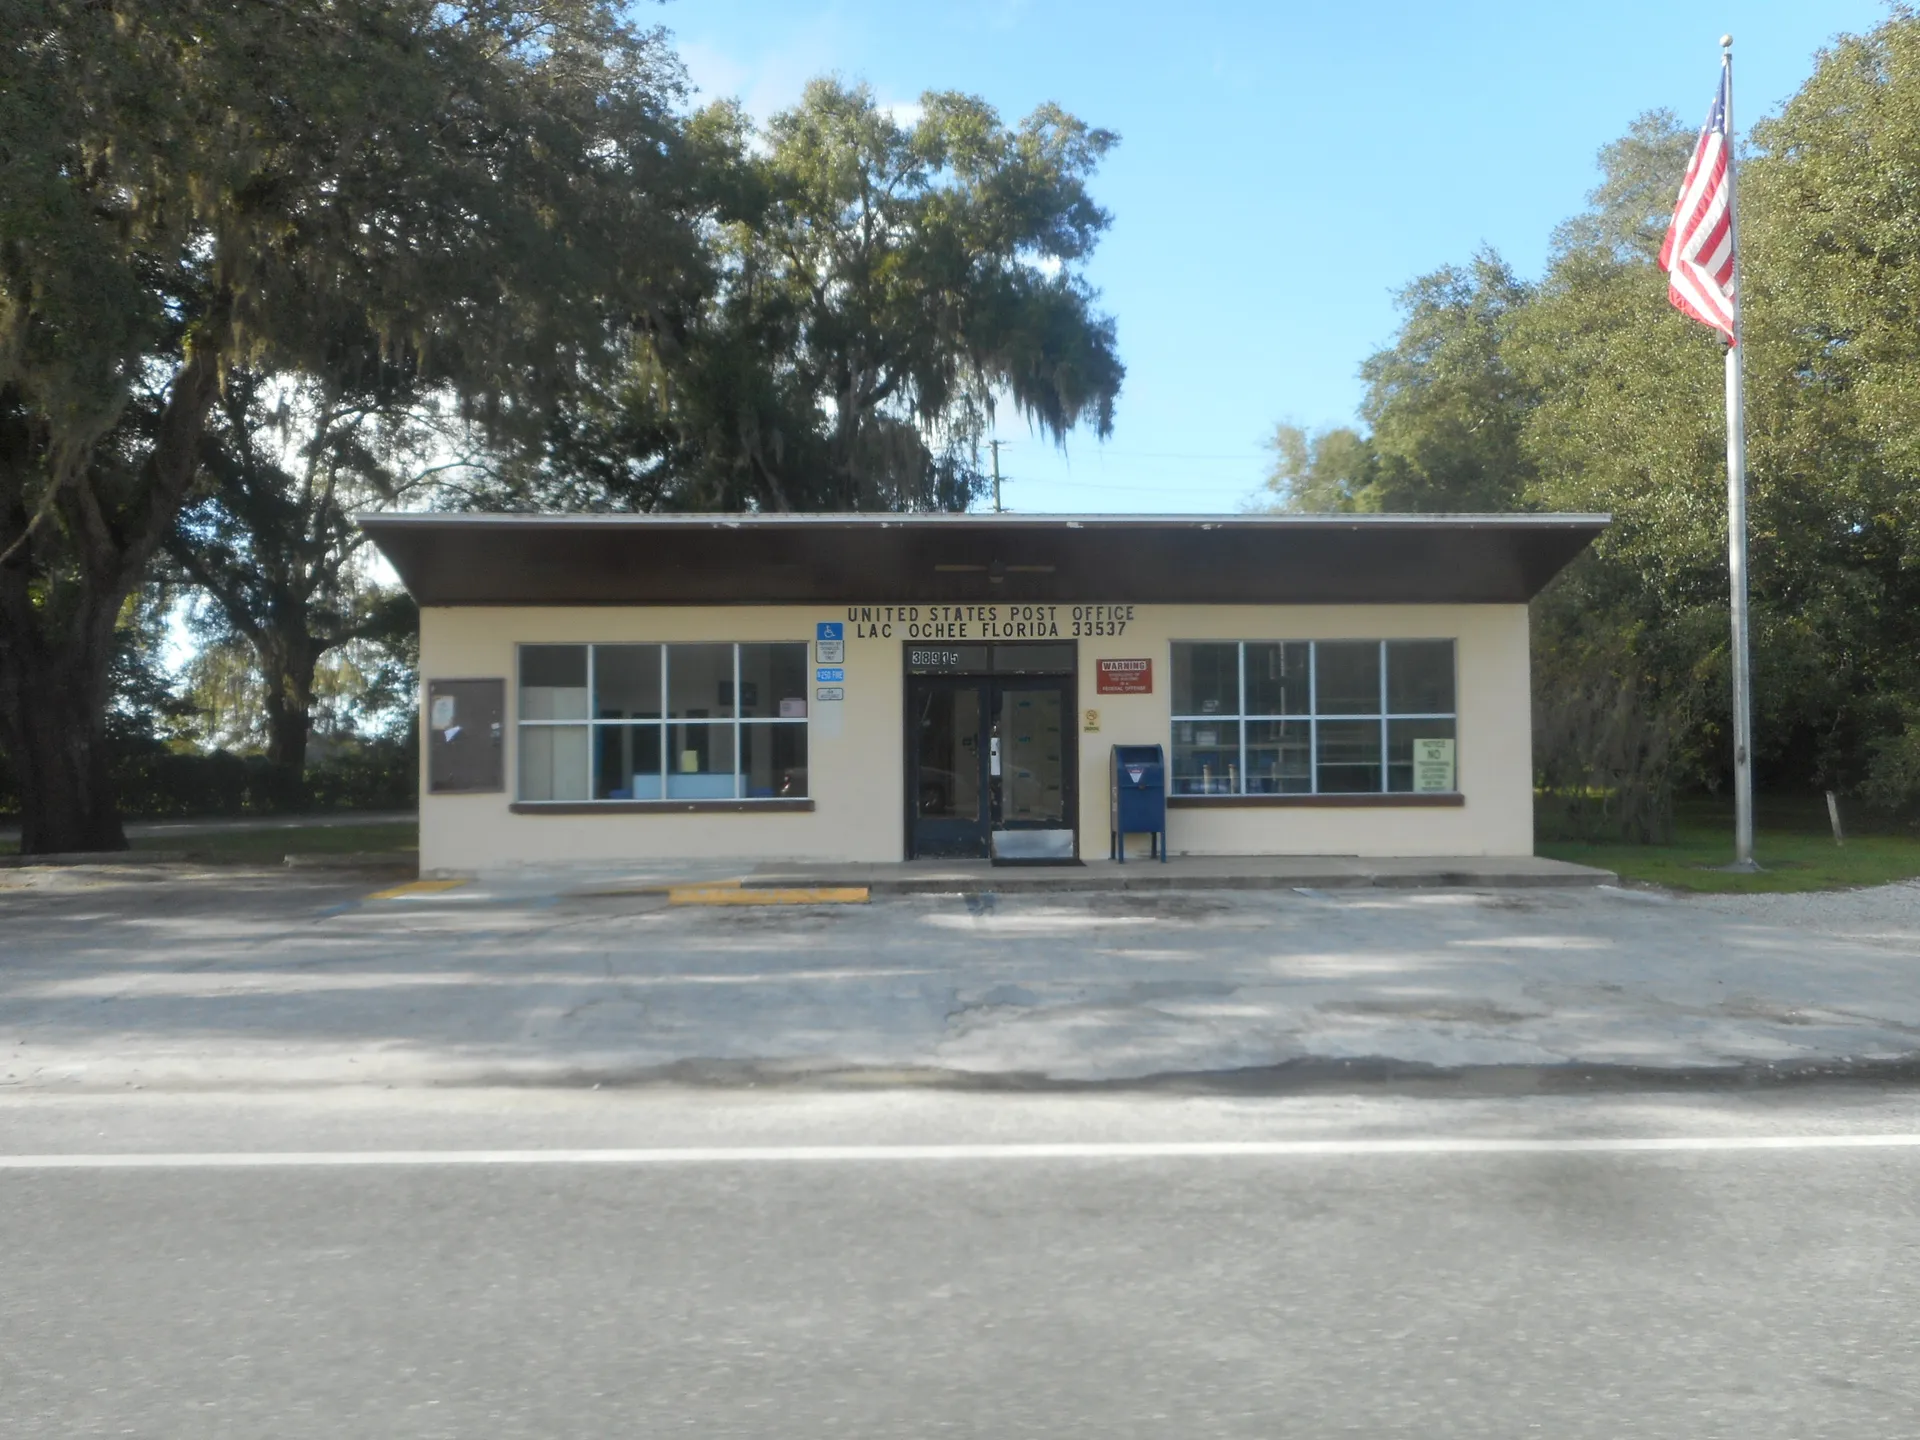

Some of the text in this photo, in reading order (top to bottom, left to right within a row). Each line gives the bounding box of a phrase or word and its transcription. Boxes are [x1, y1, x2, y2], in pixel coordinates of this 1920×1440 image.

[848, 606, 1134, 622] UNITED STATES POST OFFICE
[982, 622, 1059, 637] FLORIDA
[1072, 621, 1126, 637] 33537
[912, 651, 959, 665] 38915
[1102, 661, 1146, 670] WARNING
[1427, 749, 1441, 760] NO
